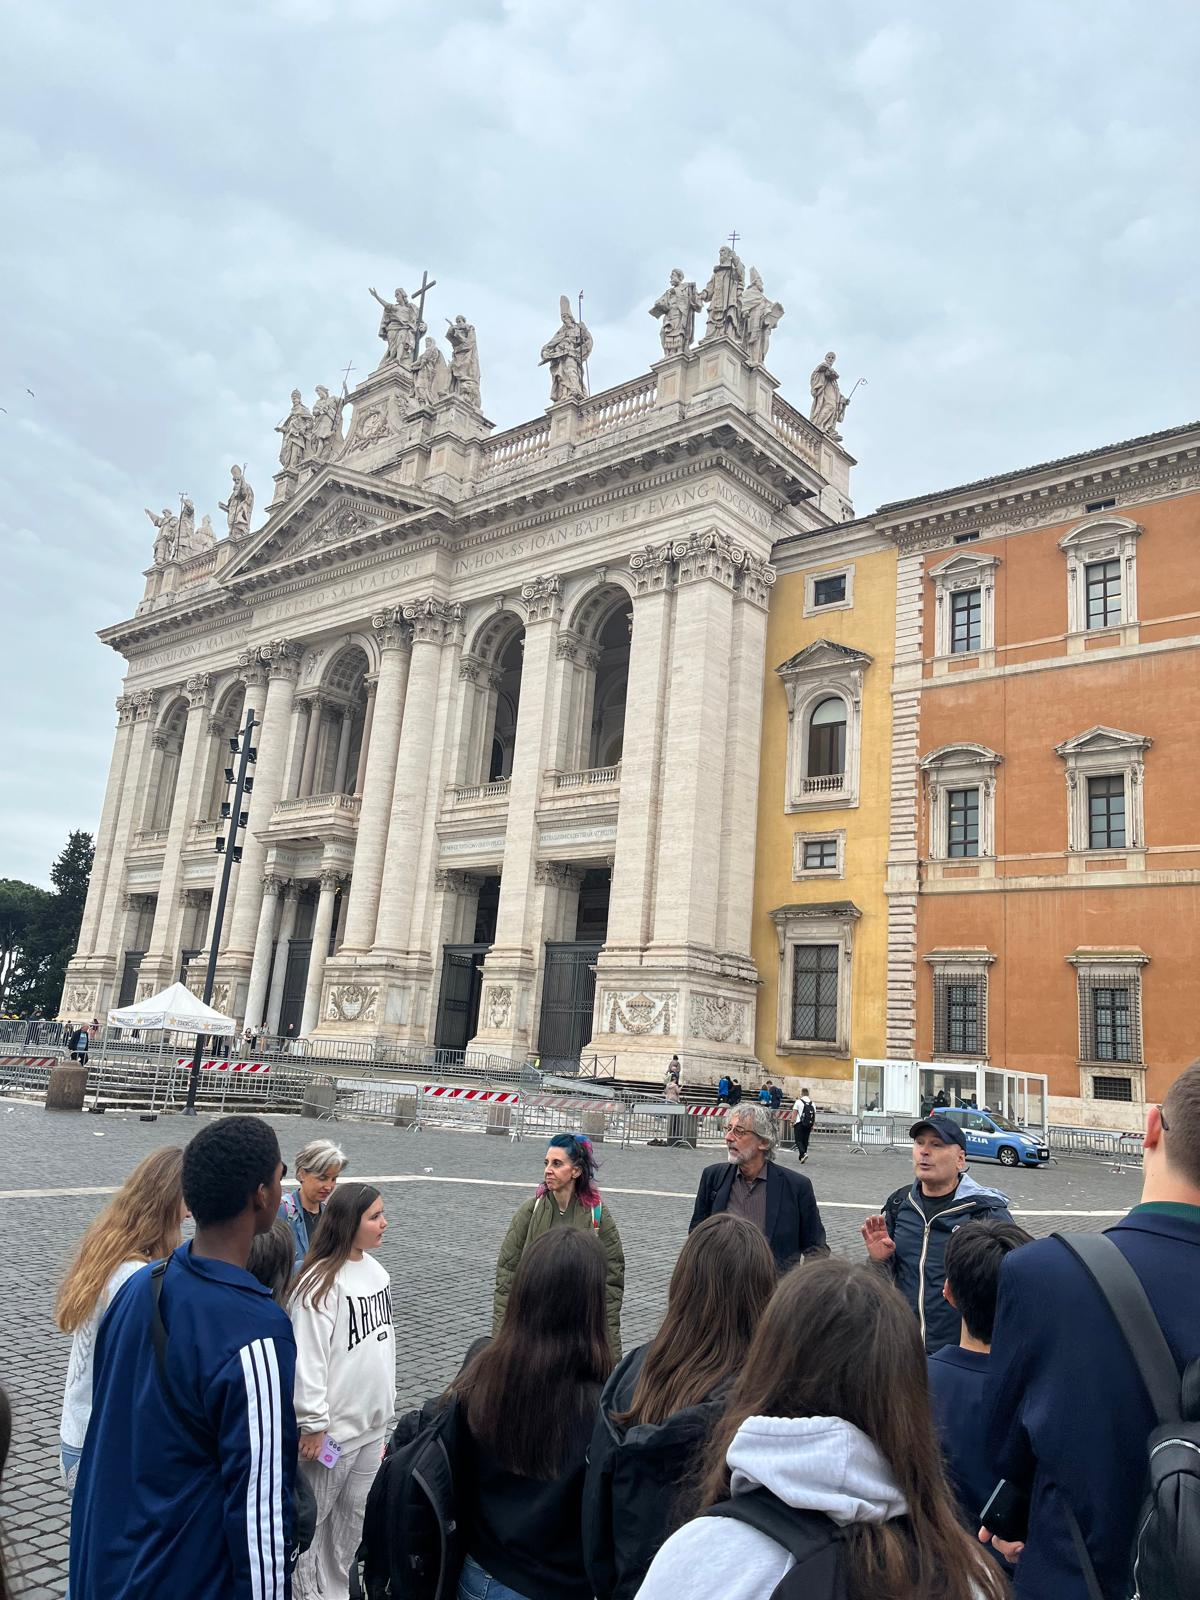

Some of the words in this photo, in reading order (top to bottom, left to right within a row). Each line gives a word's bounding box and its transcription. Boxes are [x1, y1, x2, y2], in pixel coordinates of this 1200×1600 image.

[455, 559, 469, 574] IN
[475, 549, 504, 568] HON
[511, 542, 524, 557] SS
[575, 513, 613, 537] BAPT
[622, 503, 641, 522] ET
[648, 482, 710, 514] EVANG
[266, 592, 325, 620] CHRISTO
[331, 561, 419, 598] SALVATORI
